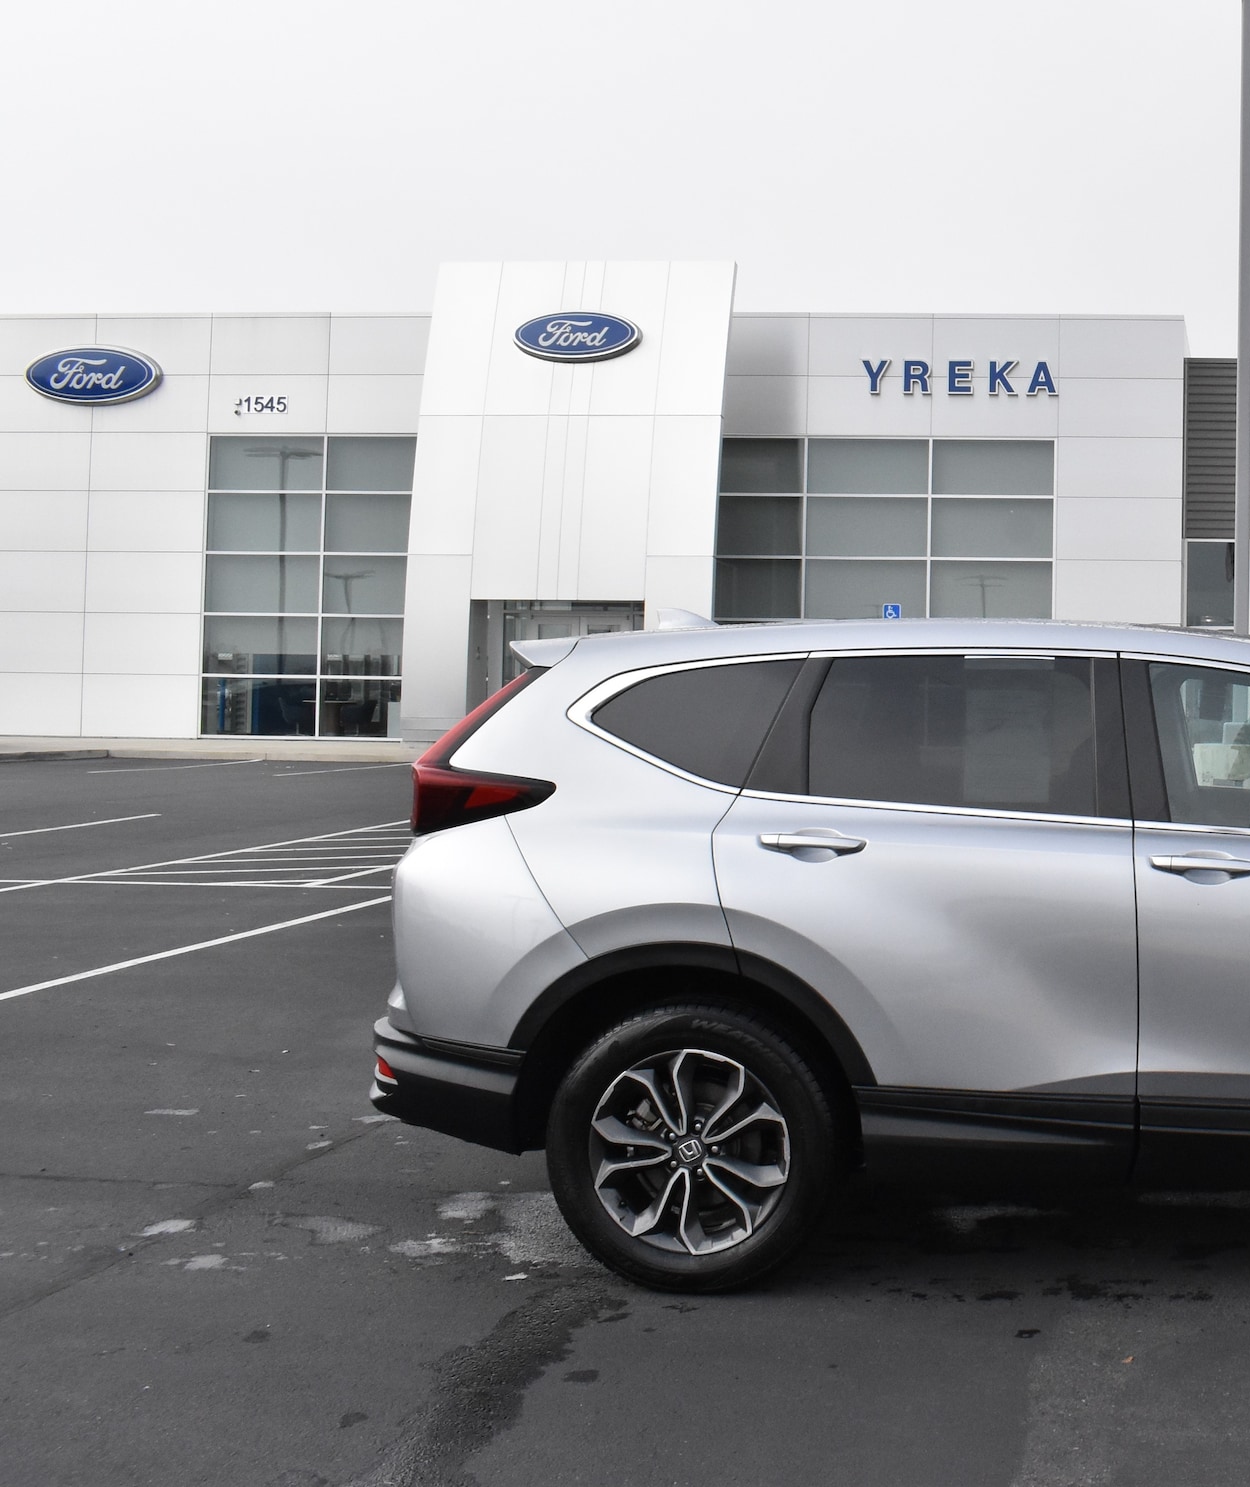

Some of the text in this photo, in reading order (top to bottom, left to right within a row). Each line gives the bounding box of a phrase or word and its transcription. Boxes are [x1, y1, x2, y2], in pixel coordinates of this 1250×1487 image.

[538, 319, 610, 347] Ford
[49, 357, 126, 389] Ford
[861, 358, 1059, 396] YREKA
[243, 396, 287, 413] 1545
